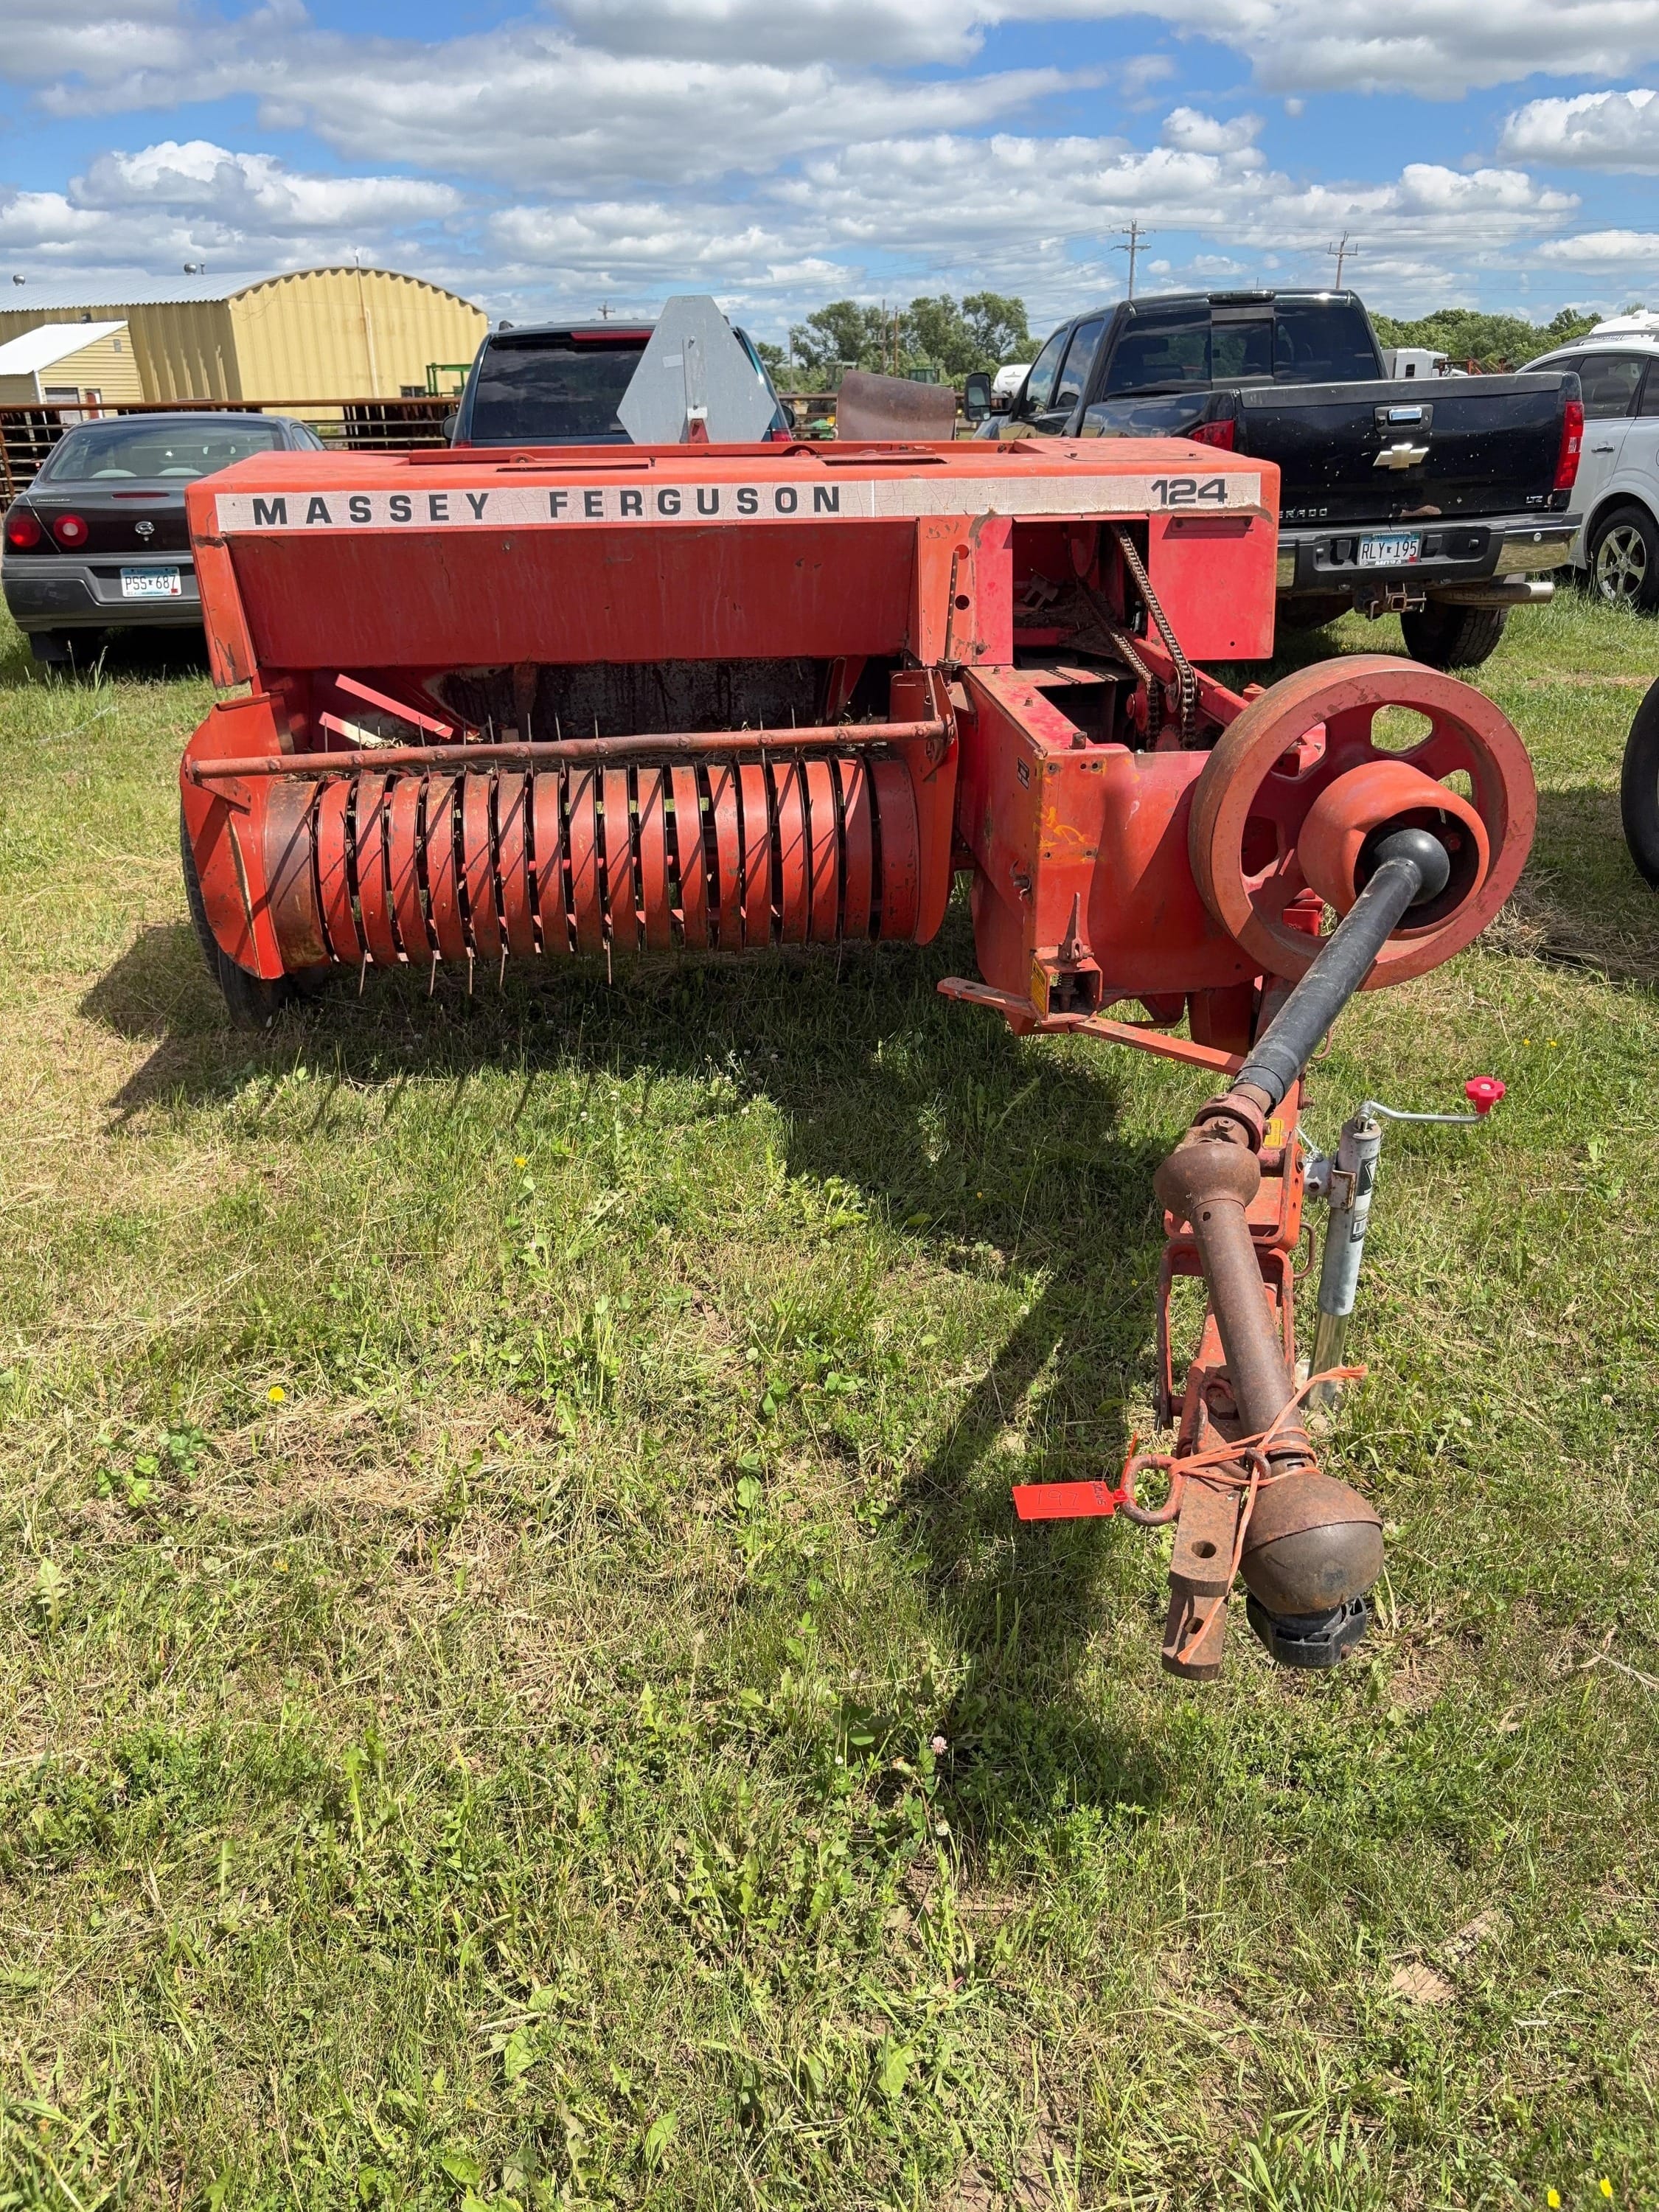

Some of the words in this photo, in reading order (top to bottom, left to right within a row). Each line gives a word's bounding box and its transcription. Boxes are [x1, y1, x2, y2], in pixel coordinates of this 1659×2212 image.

[1150, 479, 1228, 505] 124
[1526, 495, 1543, 504] LTZ
[252, 493, 489, 526] MASSEY
[549, 486, 839, 518] FERGUSON
[1362, 542, 1385, 559] RLY
[1394, 540, 1417, 558] 195
[125, 576, 147, 591] PSS
[156, 574, 175, 590] 687
[1038, 1489, 1077, 1506] 197
